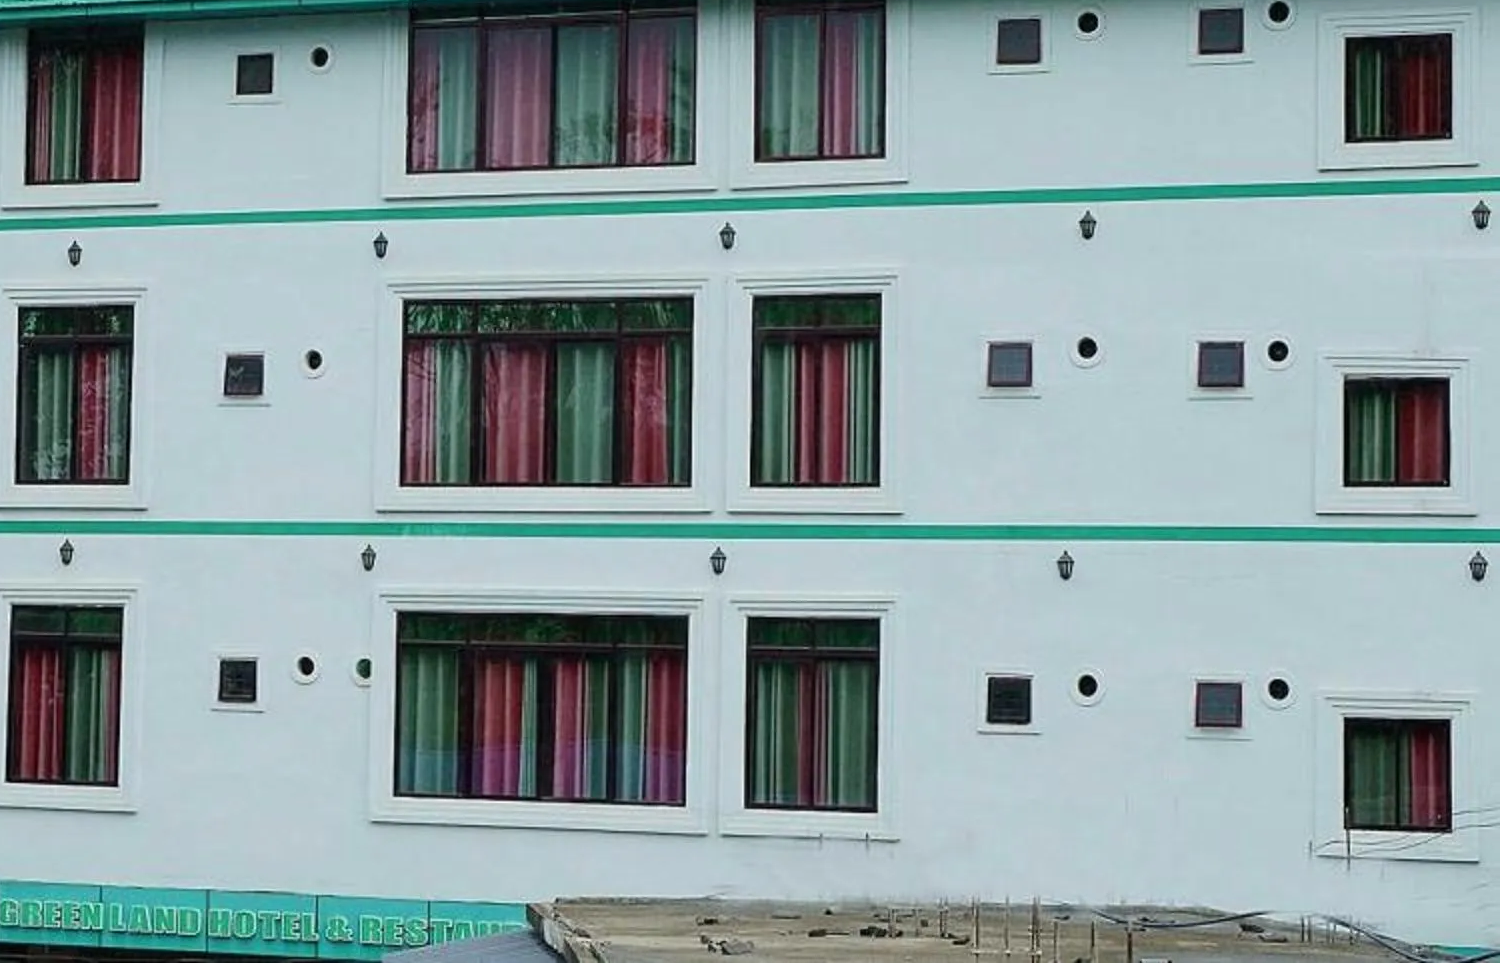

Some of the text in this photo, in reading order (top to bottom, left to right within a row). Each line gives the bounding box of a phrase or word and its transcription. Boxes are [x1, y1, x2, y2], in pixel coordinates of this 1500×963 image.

[109, 903, 200, 936] LAND
[208, 909, 320, 941] HOTEL
[325, 915, 353, 941] &
[359, 915, 526, 946] RESTA
